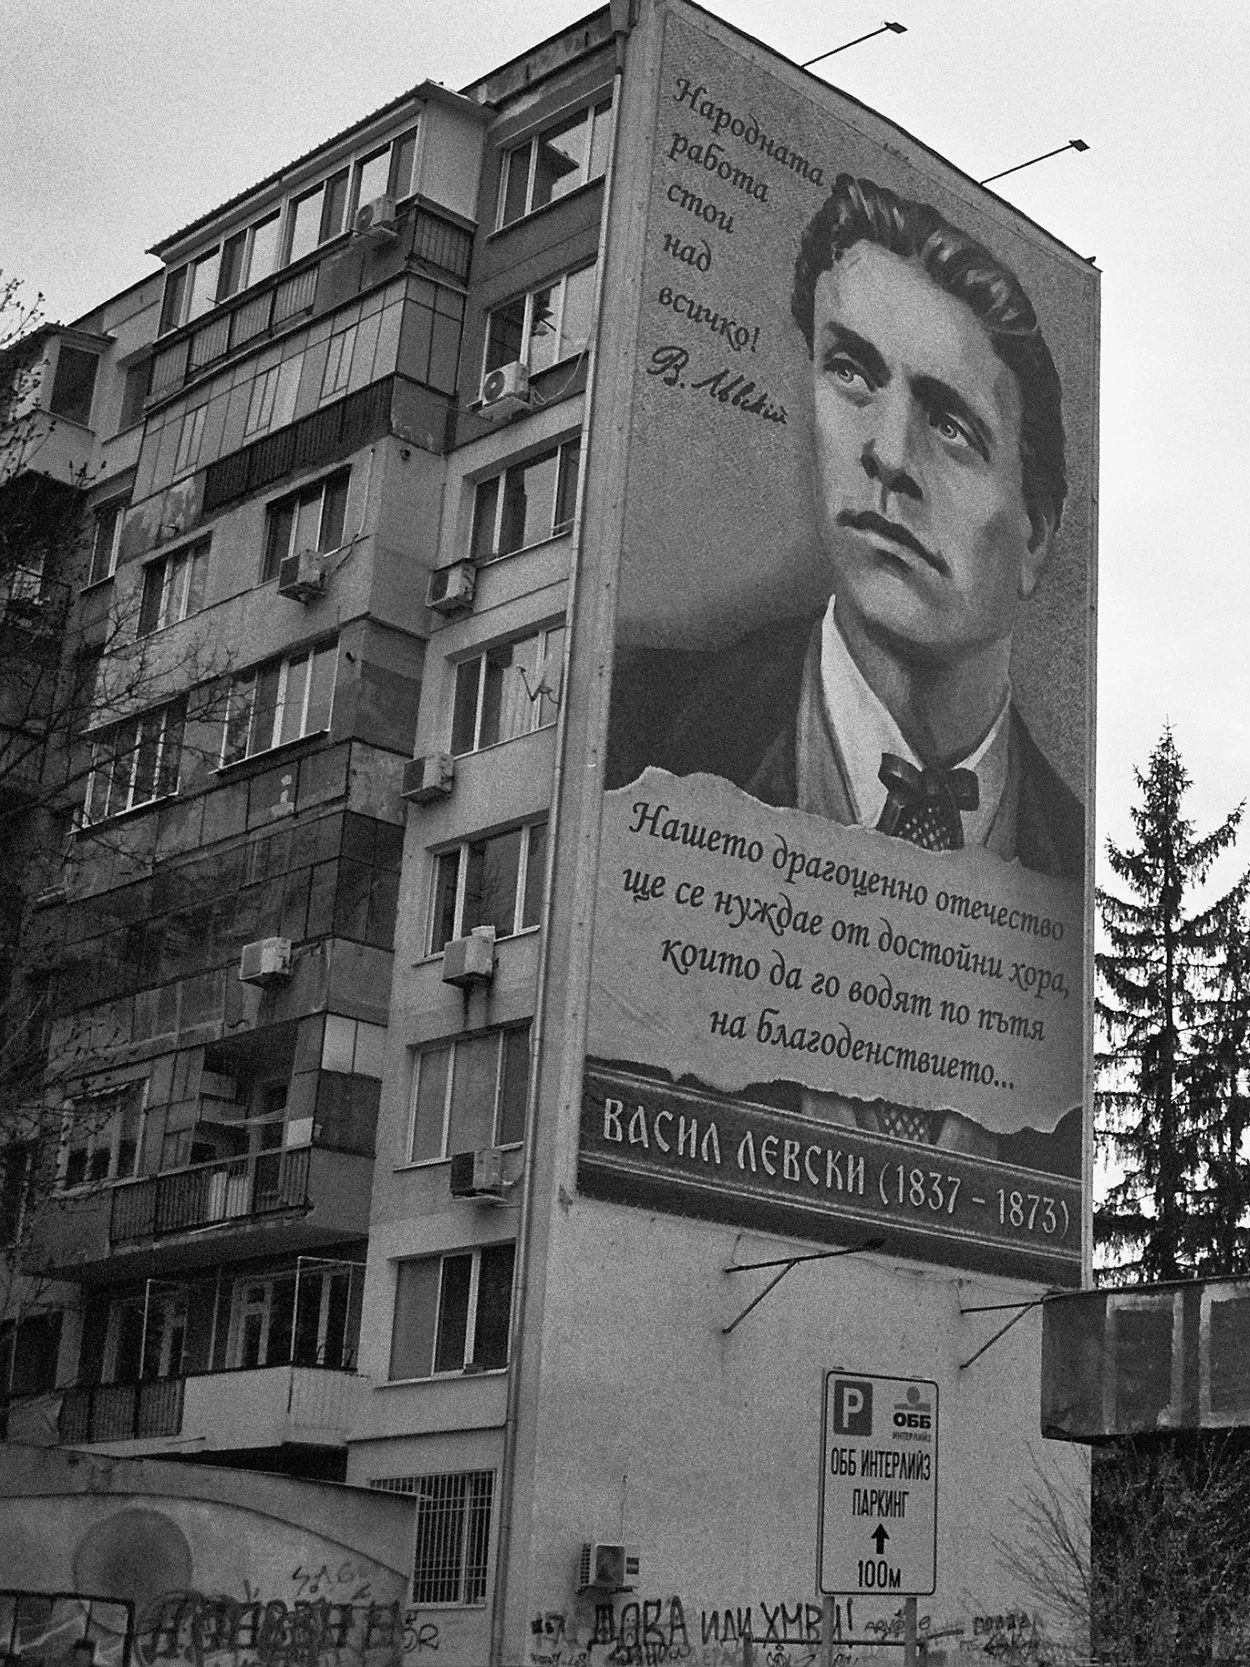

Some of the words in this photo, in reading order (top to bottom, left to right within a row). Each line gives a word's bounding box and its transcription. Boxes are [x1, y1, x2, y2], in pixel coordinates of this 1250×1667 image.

[672, 78, 825, 187] Народната
[667, 132, 769, 203] работа
[667, 182, 735, 235] стои
[663, 231, 712, 273] над
[658, 285, 761, 353] всичко!
[628, 801, 764, 863] Нашето
[772, 833, 928, 906] драгоценно
[935, 893, 1065, 941] отечество
[622, 867, 666, 903] ще
[675, 882, 705, 908] се
[714, 890, 823, 936] нуждае
[831, 918, 870, 947] от
[878, 916, 1003, 980] достойни
[1008, 960, 1070, 997] хора,
[661, 936, 761, 981] които
[769, 949, 804, 990] да
[811, 969, 840, 997] го
[848, 973, 932, 1019] водят
[940, 996, 971, 1026] по
[977, 1004, 1046, 1042] пътя
[710, 1009, 746, 1039] на
[756, 1008, 1015, 1090] благоденствието...
[603, 1098, 722, 1164] ВАСИЛ
[737, 1130, 866, 1195] ЛЕВСКИ
[879, 1161, 962, 1214] (1837
[997, 1189, 1070, 1240] 1873)
[843, 1387, 864, 1429] P
[893, 1412, 932, 1430] ОББ
[831, 1447, 857, 1477] ОББ
[861, 1450, 931, 1481] ИНТЕРЛИЙЗ
[852, 1488, 910, 1518] ПАРКИНГ
